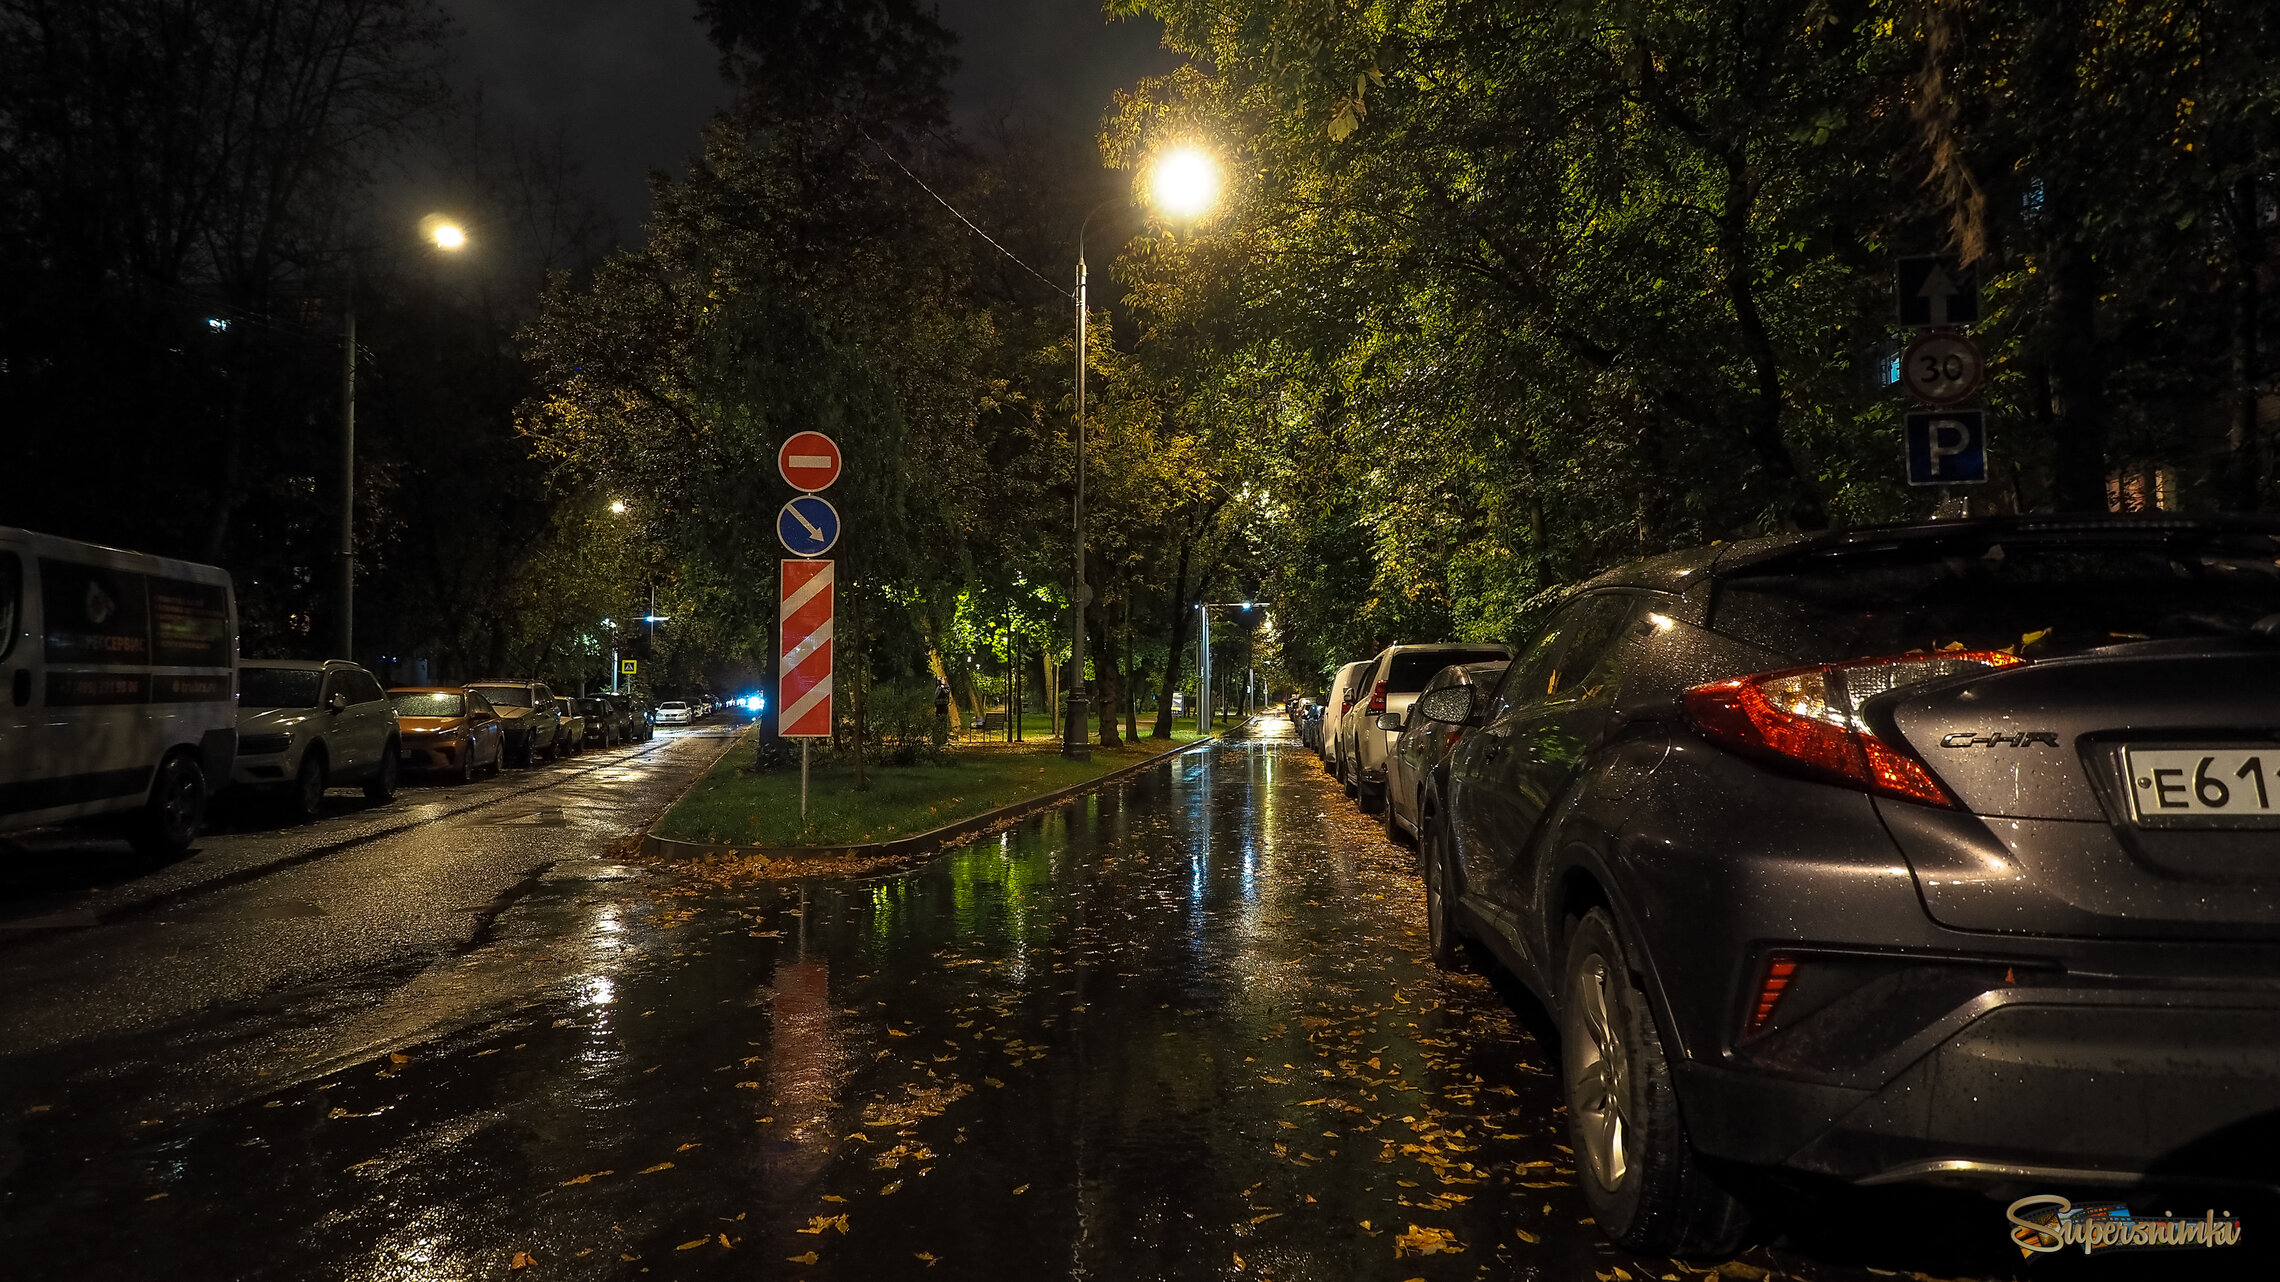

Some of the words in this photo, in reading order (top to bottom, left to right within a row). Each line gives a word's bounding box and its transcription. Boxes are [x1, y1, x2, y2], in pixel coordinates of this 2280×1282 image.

[1920, 355, 1963, 383] 30
[1928, 419, 1971, 476] P
[1940, 732, 2060, 748] C-HR
